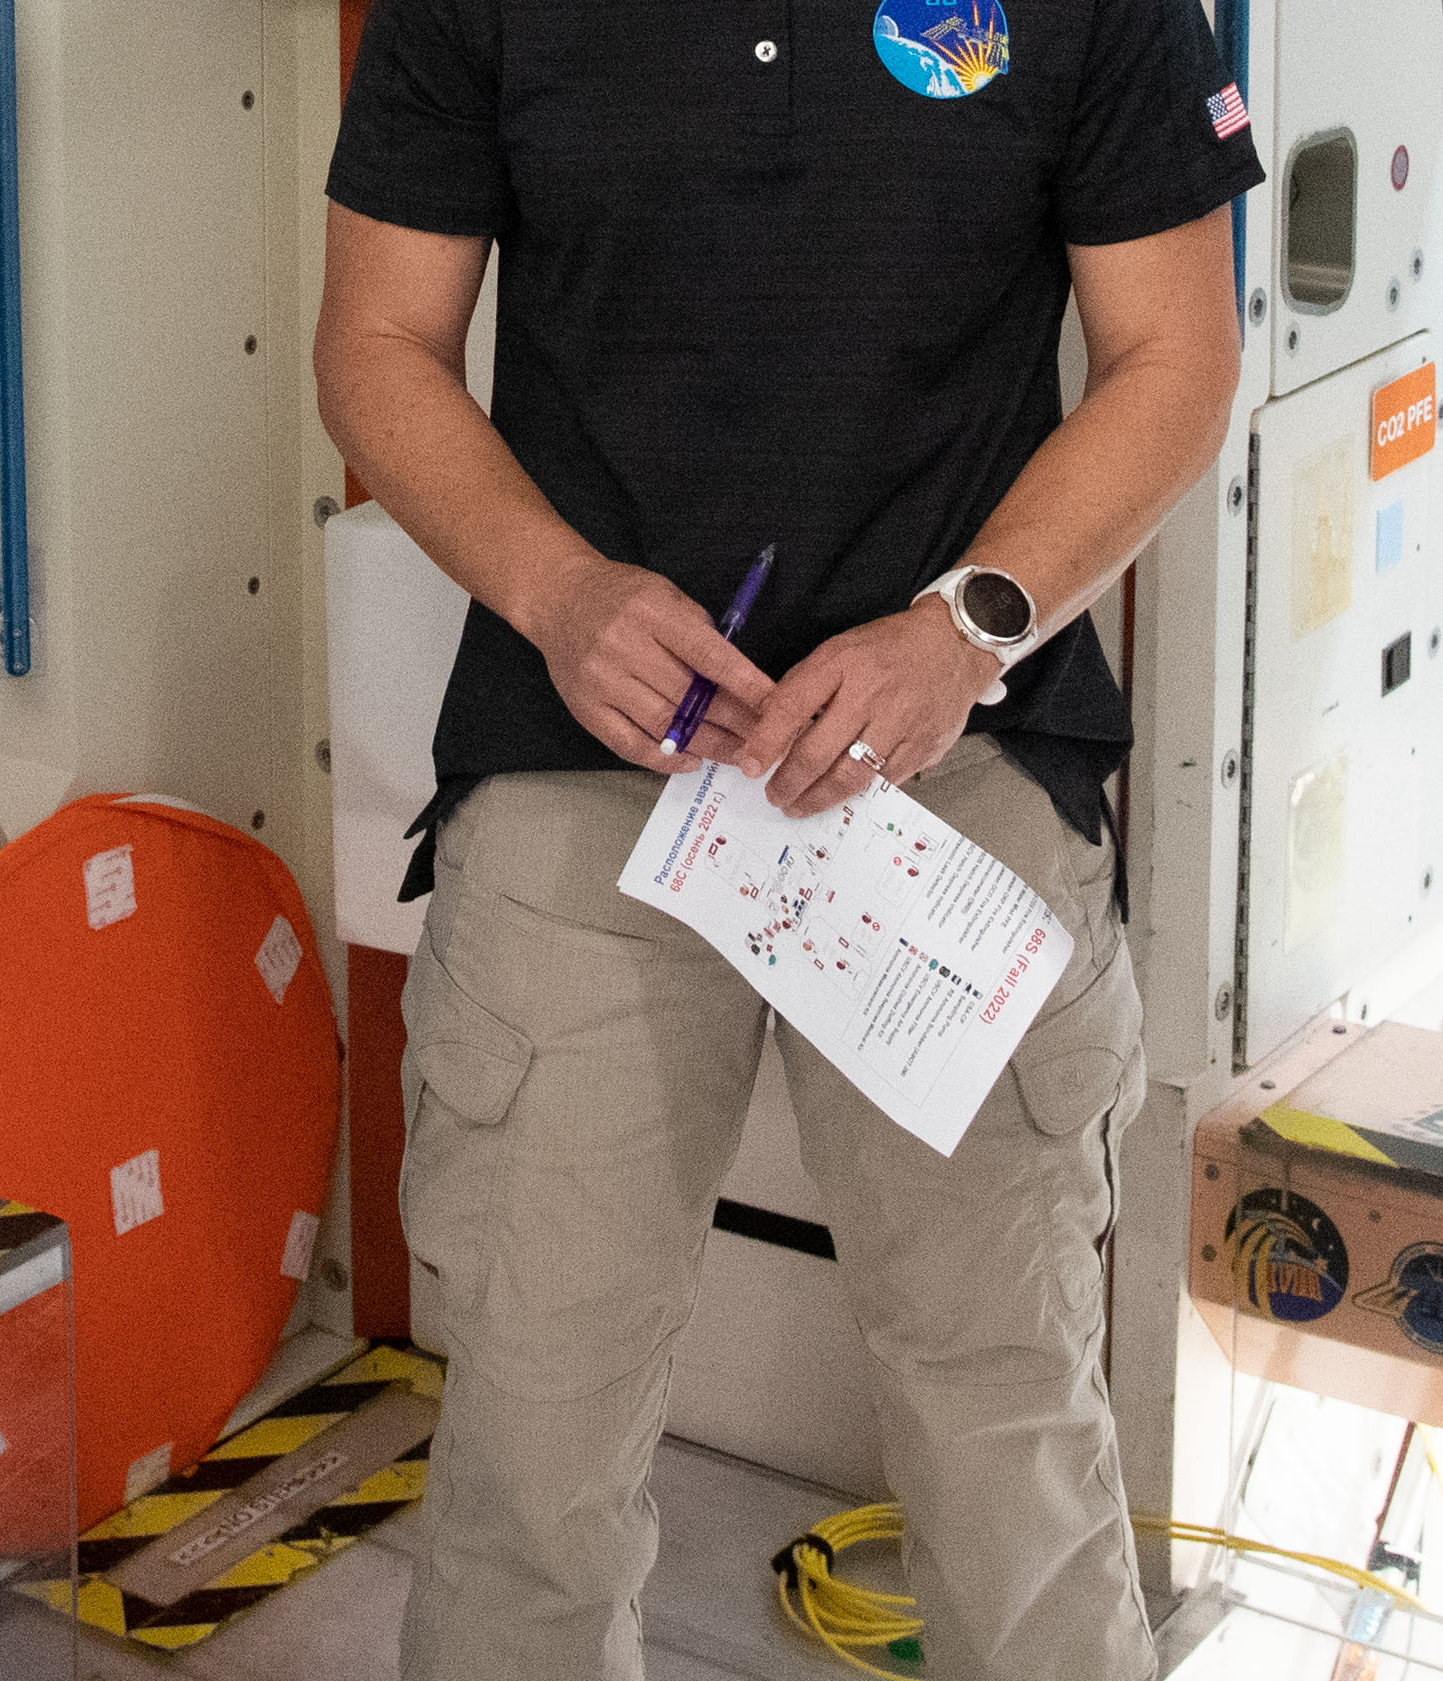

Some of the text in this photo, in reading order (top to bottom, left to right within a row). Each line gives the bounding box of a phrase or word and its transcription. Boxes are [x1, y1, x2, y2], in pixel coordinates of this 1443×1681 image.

[1377, 394, 1433, 447] CO2 PFE
[654, 806, 699, 885] Расположение
[681, 834, 705, 870] (осень
[698, 804, 718, 831] 2022
[979, 928, 1046, 1024] 68S (Fall 2022)
